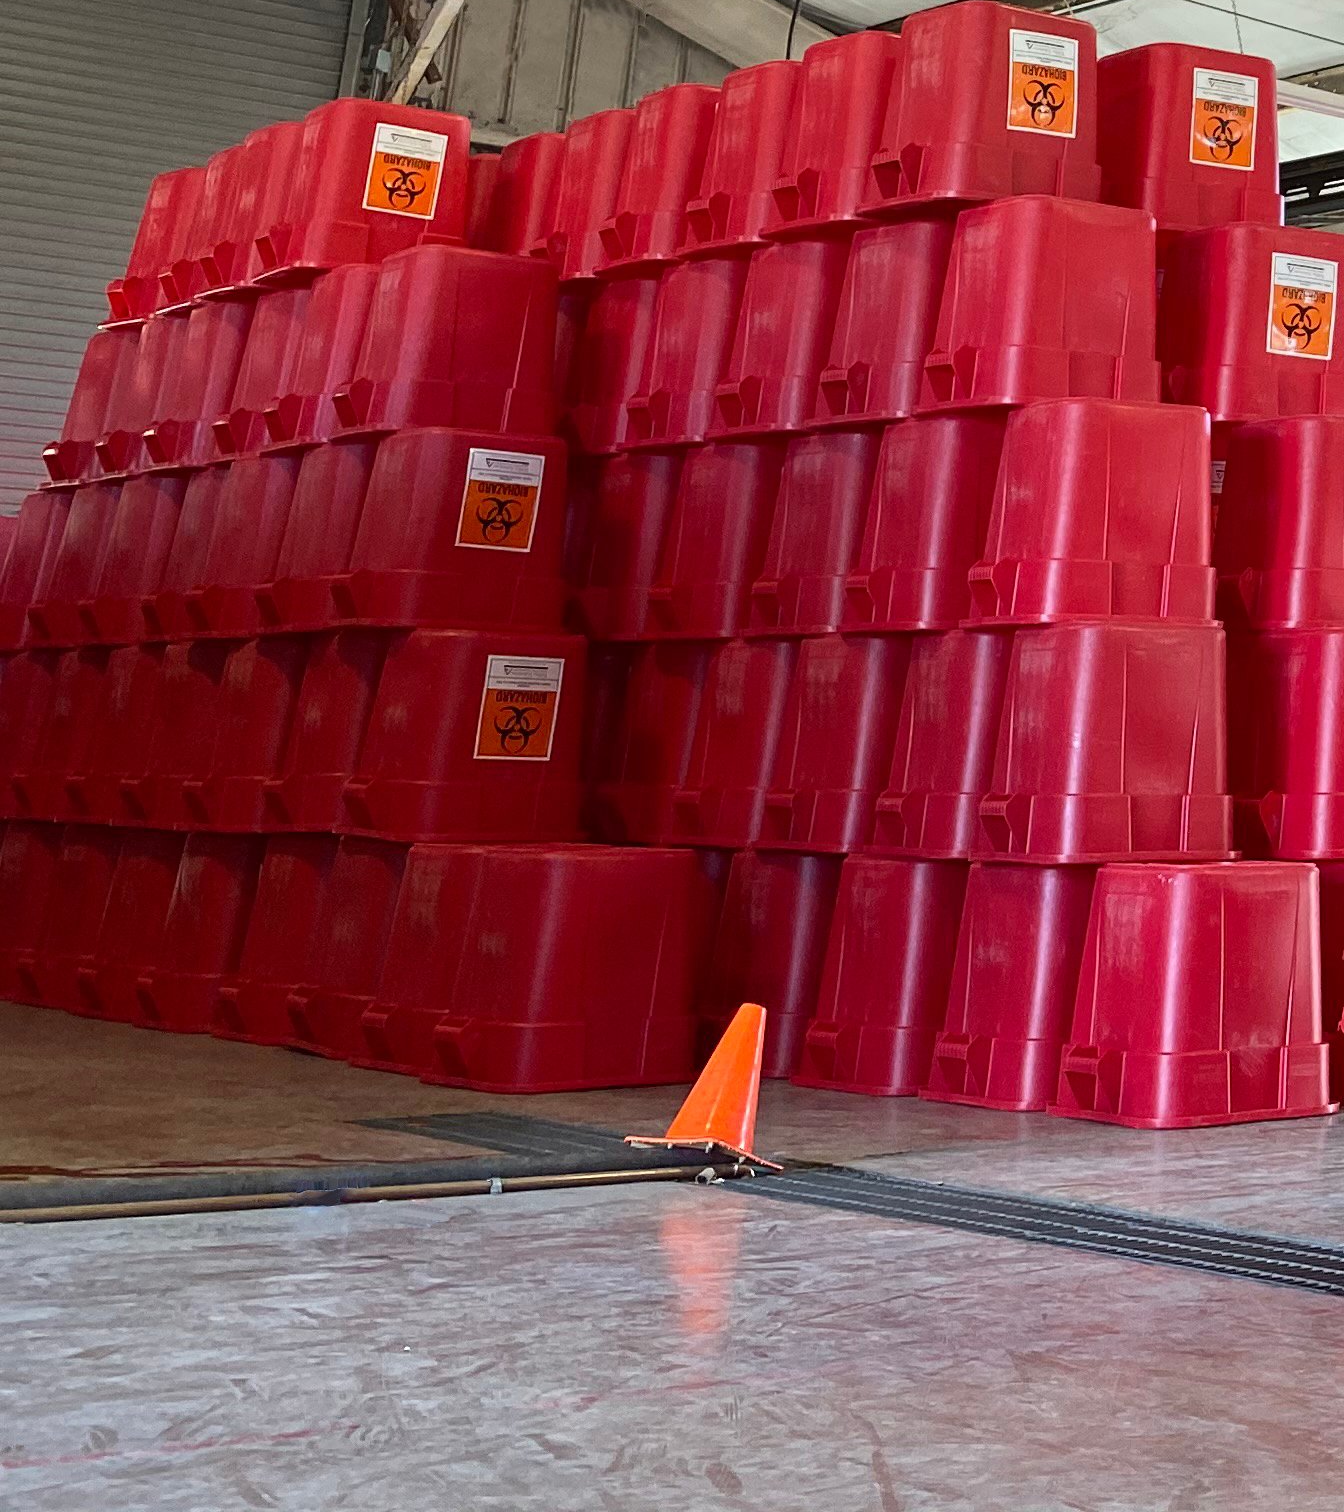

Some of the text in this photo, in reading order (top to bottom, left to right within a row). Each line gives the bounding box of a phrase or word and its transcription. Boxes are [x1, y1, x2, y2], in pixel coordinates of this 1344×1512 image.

[1021, 63, 1067, 81] BIOHAZARD
[1203, 101, 1247, 118] BIOHAZARD
[383, 153, 431, 171] BIOHAZARD
[477, 481, 529, 498] BIOHAZARD
[495, 689, 548, 704] BIOHAZARD
